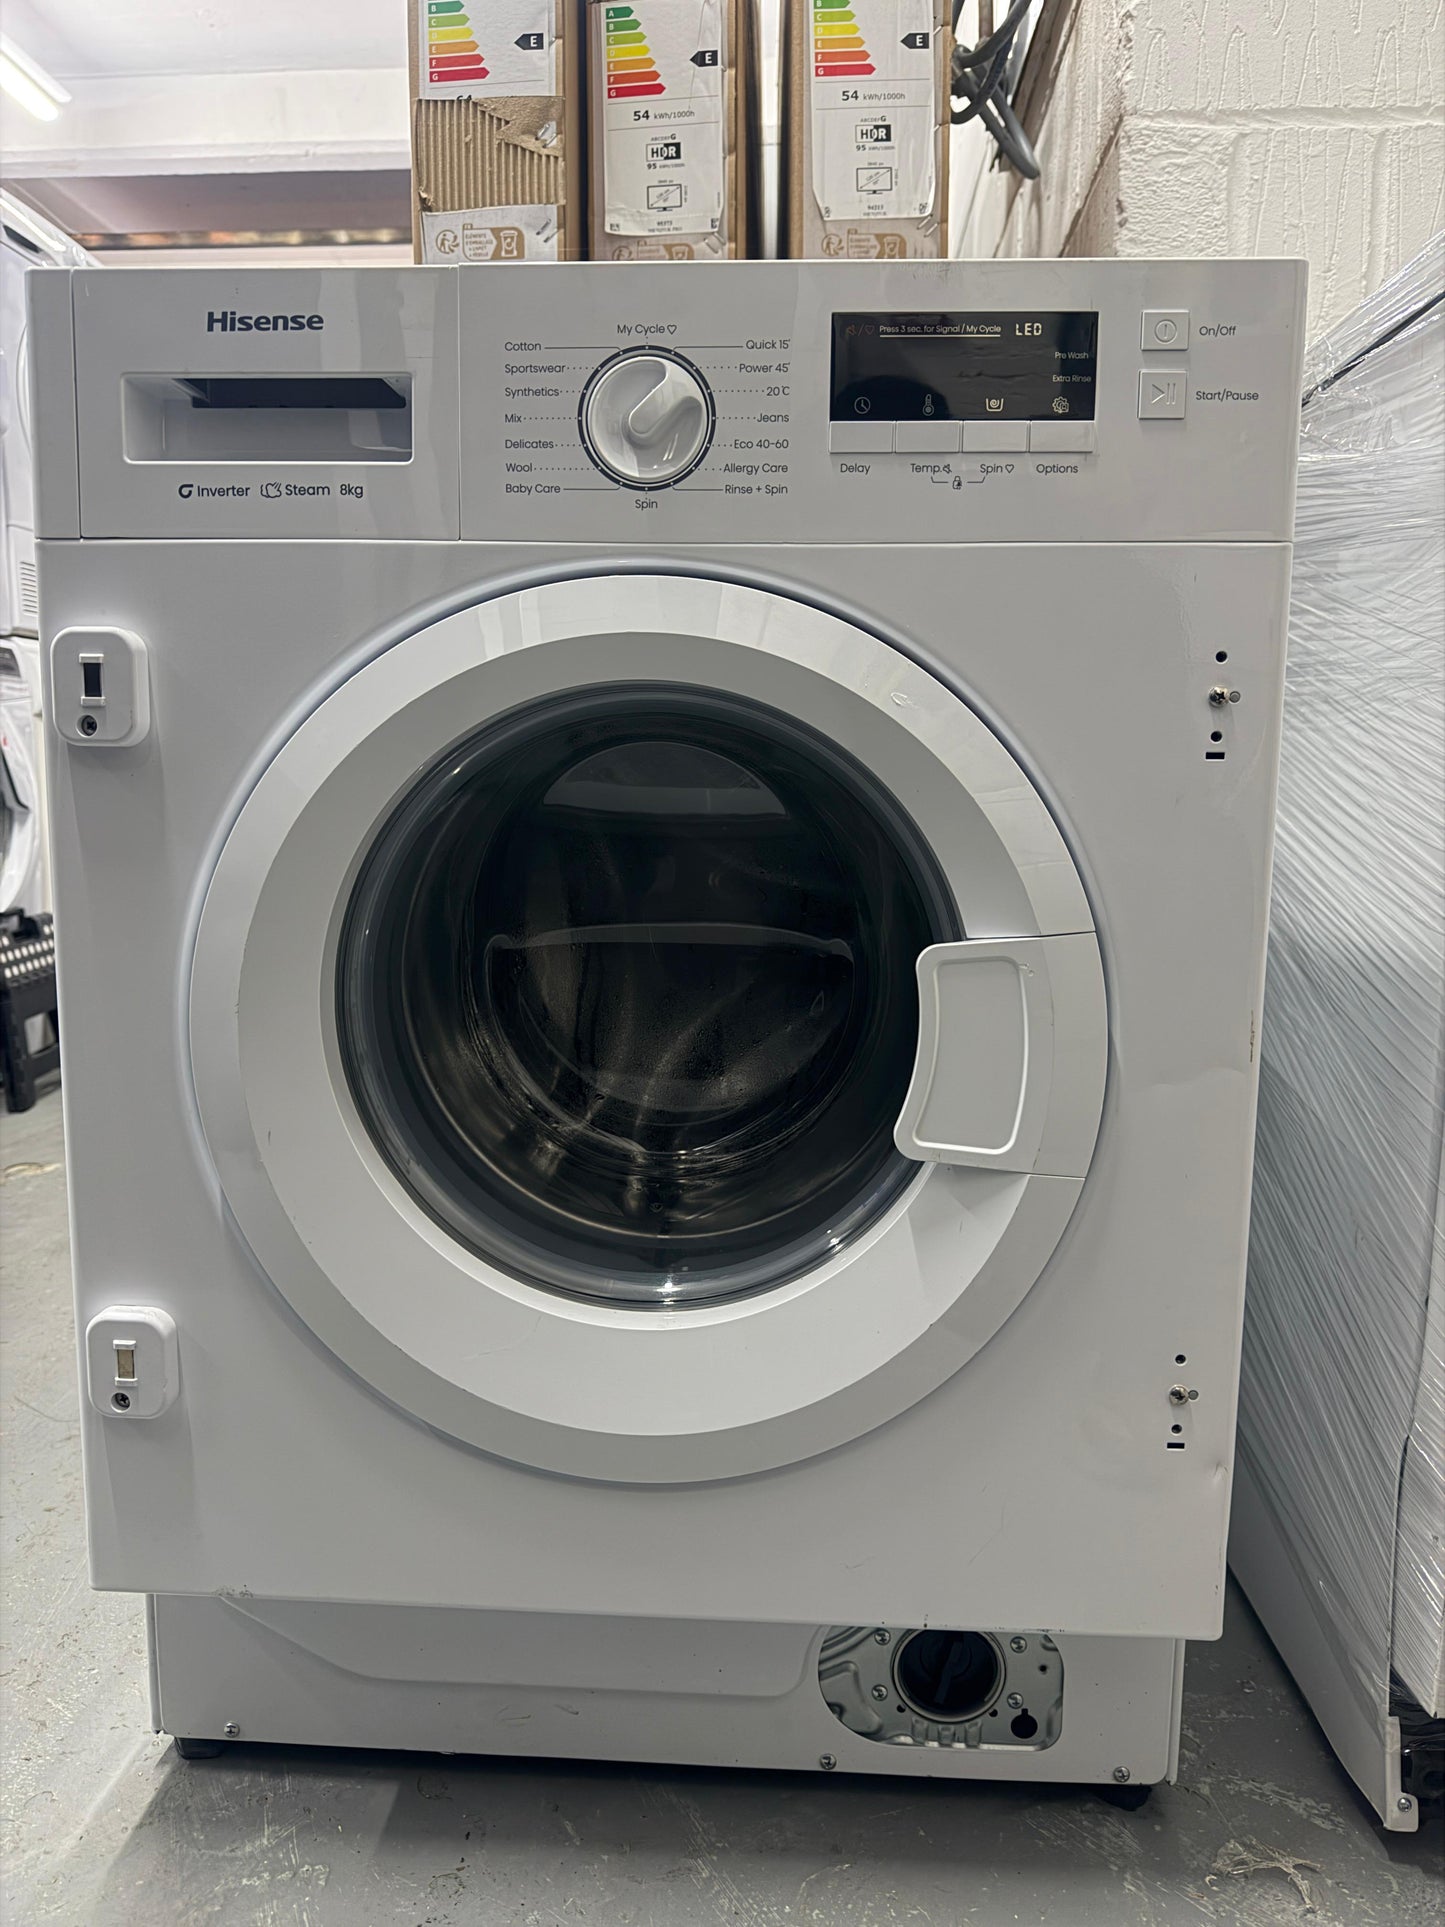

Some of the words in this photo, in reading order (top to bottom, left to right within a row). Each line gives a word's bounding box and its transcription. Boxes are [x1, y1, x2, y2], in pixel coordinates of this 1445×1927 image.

[530, 36, 538, 47] E
[609, 36, 615, 44] C
[916, 35, 923, 46] E
[705, 52, 712, 64] E
[432, 73, 439, 81] G
[842, 90, 859, 101] 54
[863, 92, 905, 101] kWh/1000h
[633, 110, 650, 121] 54
[654, 110, 695, 120] kWh/1000h
[860, 128, 887, 140] HDR
[651, 146, 677, 159] HDR
[207, 311, 324, 332] Hisense
[617, 324, 632, 336] My
[635, 324, 665, 336] Cycle
[880, 325, 899, 333] Press
[901, 325, 906, 333] 3
[924, 325, 934, 333] for
[936, 324, 960, 334] Signal
[966, 325, 978, 334] My
[979, 324, 1001, 334] Cycle
[1015, 323, 1042, 335] LED
[1199, 324, 1237, 337] On/Off
[504, 342, 541, 351] Cotton
[746, 339, 776, 350] Quick
[504, 364, 566, 375] Sportswear
[739, 363, 773, 373] Power
[504, 387, 559, 399] Synthetics
[1195, 388, 1259, 402] Start/Pause
[504, 414, 522, 423] Mix
[757, 413, 789, 423] Jeans
[505, 439, 554, 449] Delicates
[734, 439, 754, 449] Eco
[756, 439, 789, 449] 40-60
[505, 463, 533, 472] Wool
[723, 463, 760, 475] Allergy
[762, 463, 788, 473] Care
[840, 463, 870, 475] Delay
[911, 463, 942, 475] Temp.
[980, 463, 1003, 475] Spin
[1036, 463, 1079, 475] Options
[197, 485, 250, 497] Inverter
[285, 484, 330, 497] Steam
[340, 484, 364, 498] 8kg
[505, 484, 532, 495] Baby
[535, 484, 561, 493] Care
[725, 484, 753, 494] Rinse
[765, 484, 788, 496] Spin
[635, 499, 658, 510] Spin
